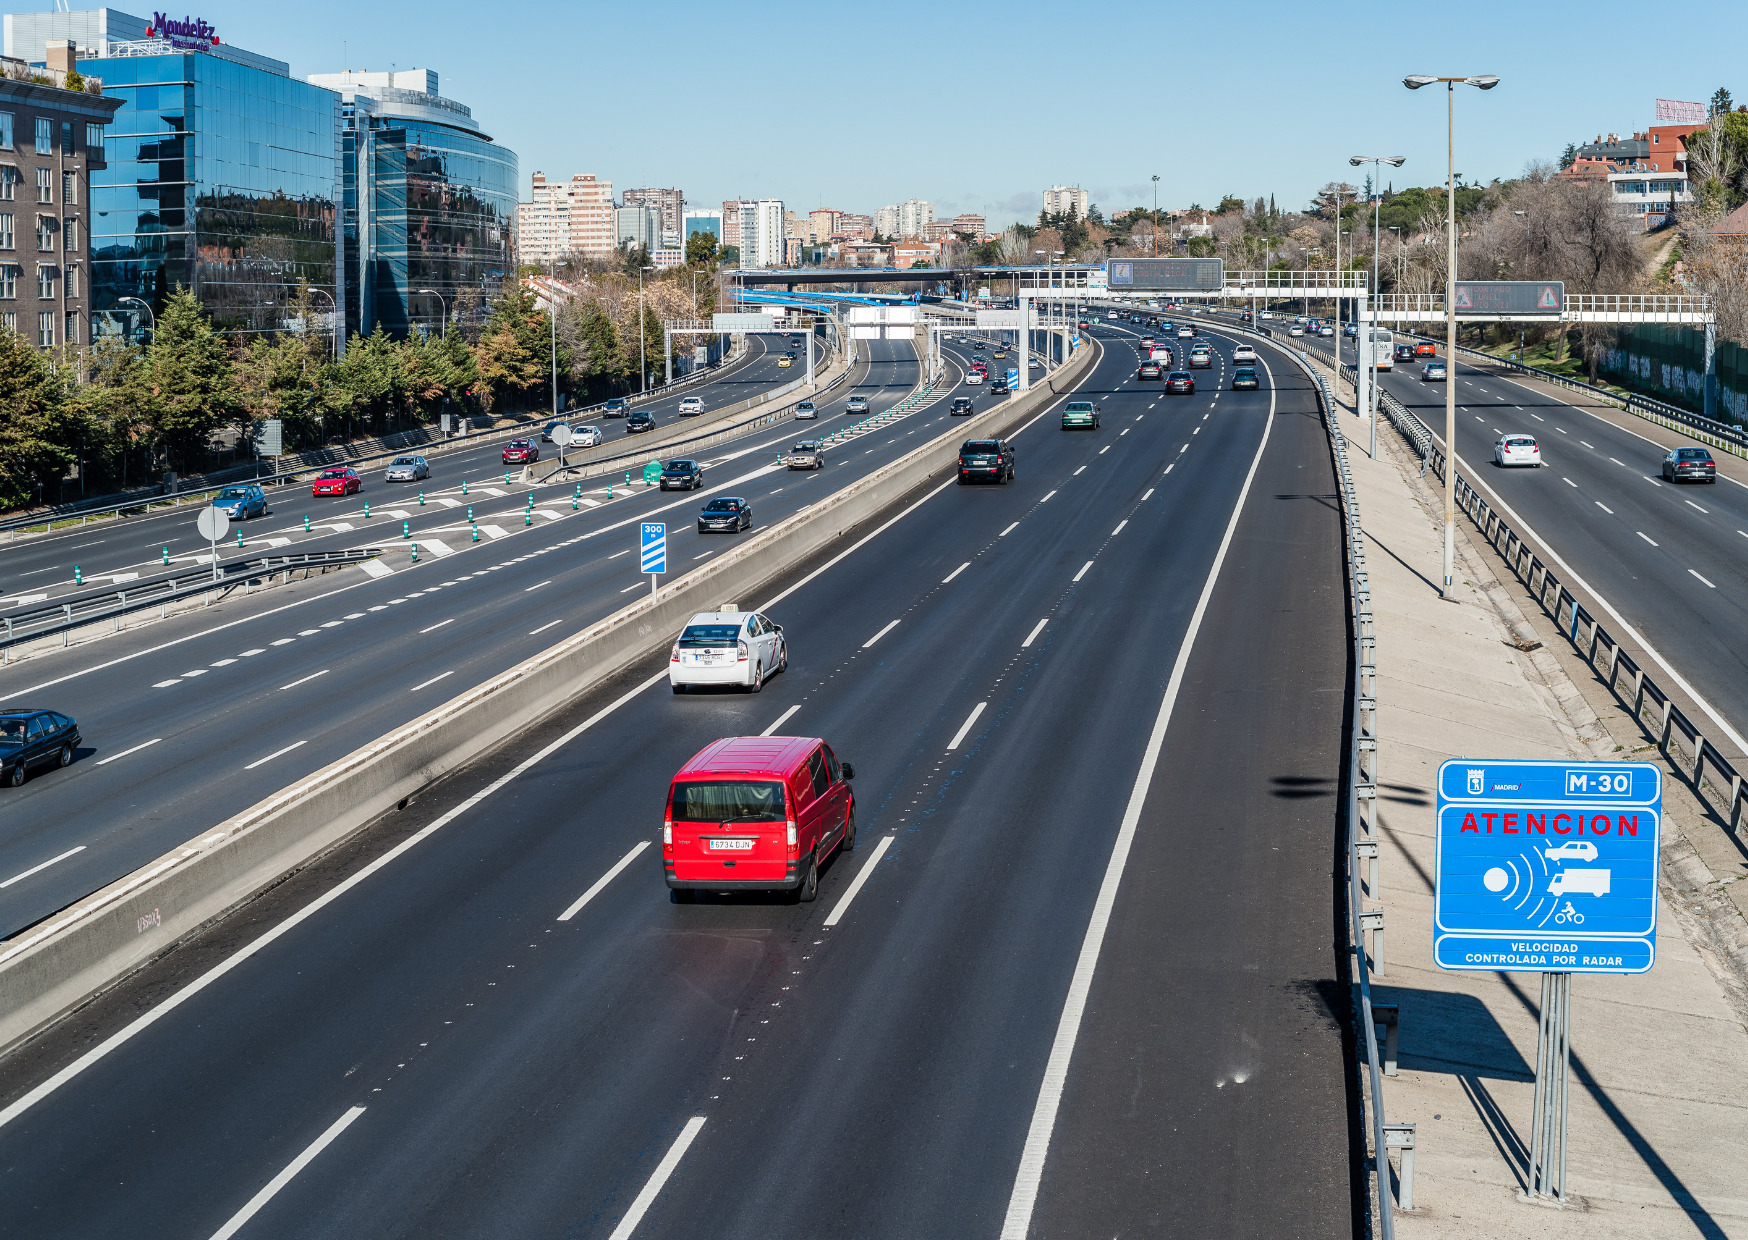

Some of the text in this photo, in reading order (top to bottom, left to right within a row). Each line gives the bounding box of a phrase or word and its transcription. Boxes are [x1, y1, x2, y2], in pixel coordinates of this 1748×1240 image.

[152, 11, 215, 40] Mondelēz
[645, 525, 662, 533] 300
[1569, 775, 1628, 792] M-30
[1460, 812, 1638, 836] ATENCION
[1511, 942, 1579, 953] VELOCIDAD
[1465, 954, 1623, 966] CONTROLADA POR RADAR
